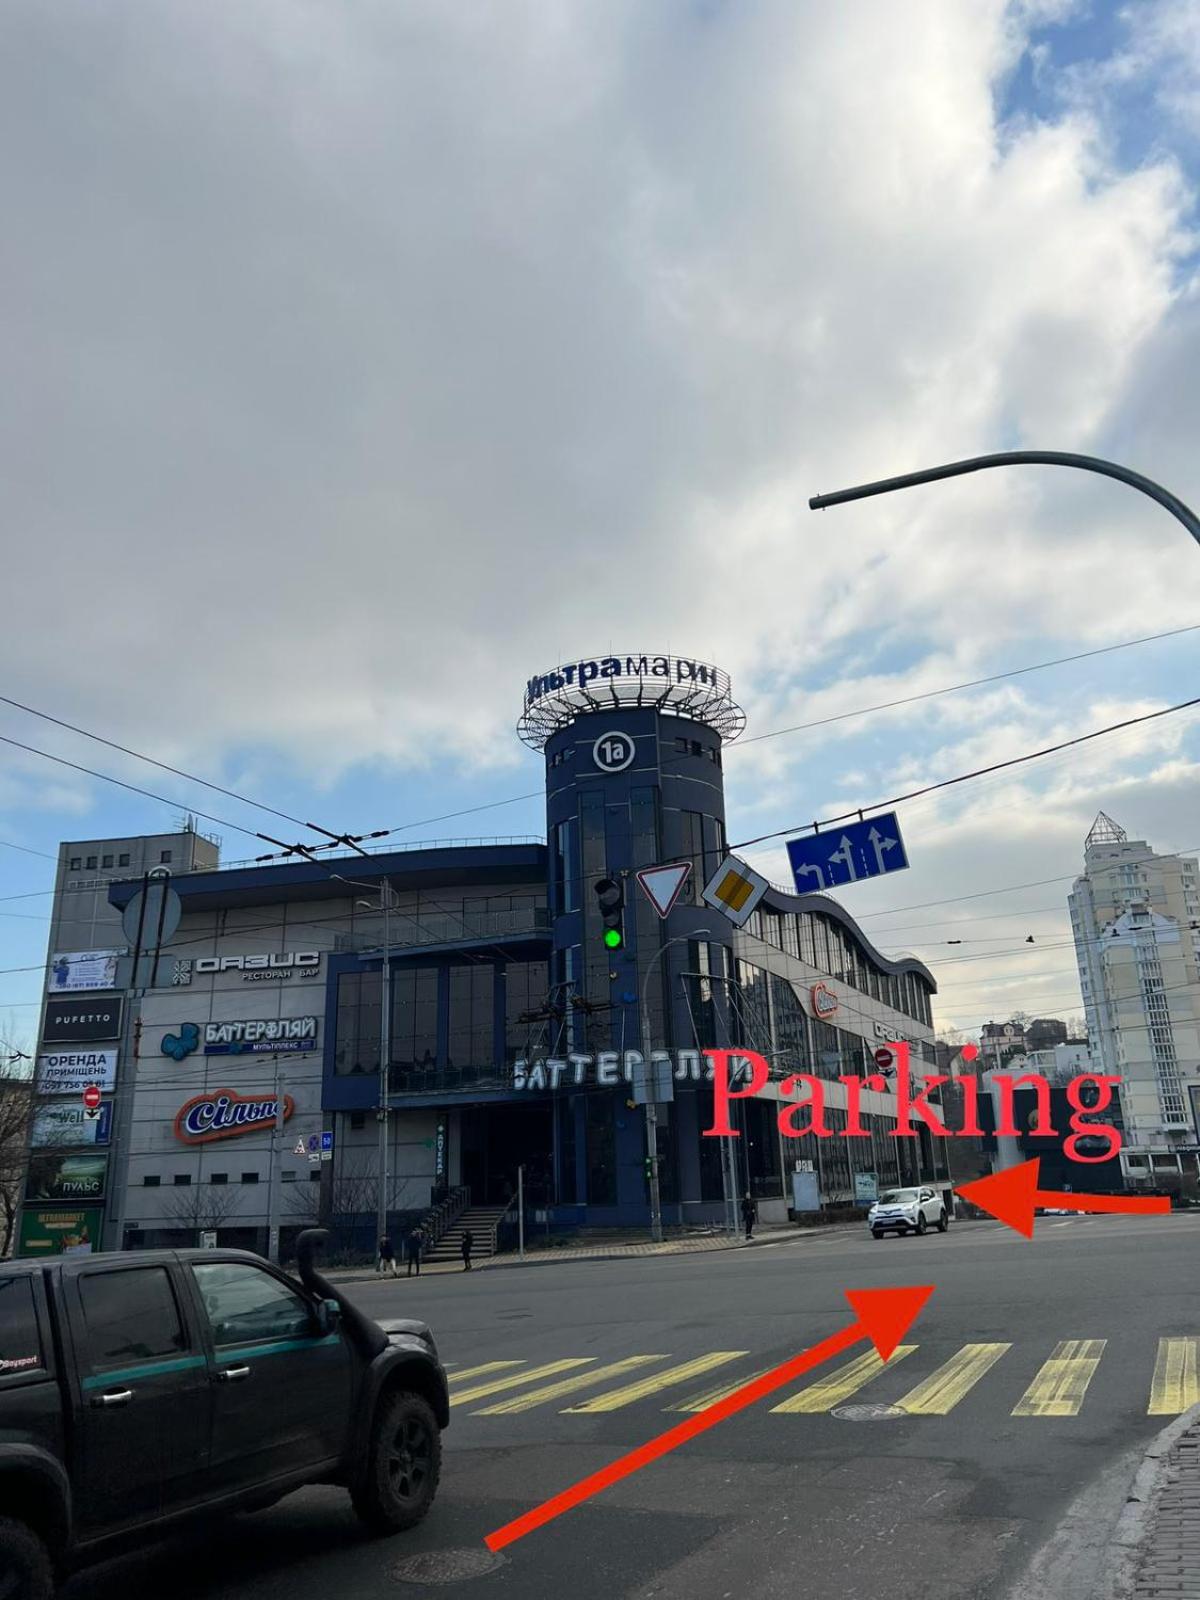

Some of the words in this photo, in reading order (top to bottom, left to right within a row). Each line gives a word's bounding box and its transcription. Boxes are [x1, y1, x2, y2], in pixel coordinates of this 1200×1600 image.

[196, 951, 319, 973] ОАЗИС
[242, 969, 291, 981] РЕСТОРАН
[300, 968, 319, 978] БАР
[55, 1014, 111, 1024] PUFETTO
[205, 1017, 316, 1043] БАТТЕРФЛЯЙ
[48, 1054, 107, 1067] ОРЕНДА
[46, 1065, 107, 1078] ПРИМІЩЕНЬ
[63, 1181, 100, 1192] ПУЛЬС
